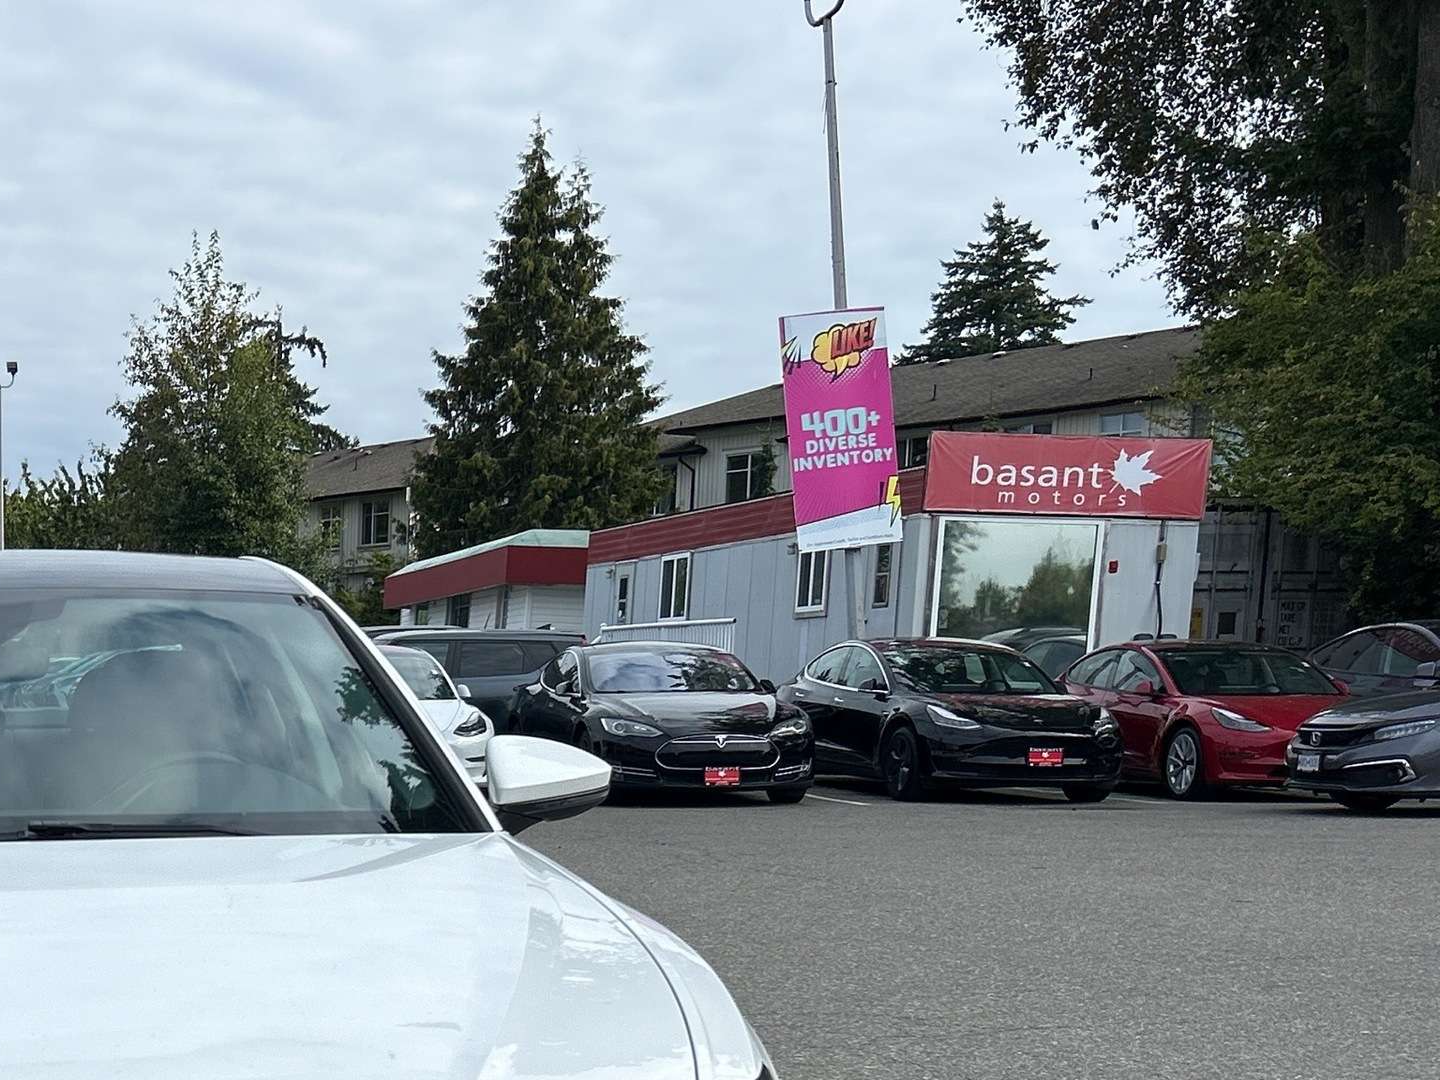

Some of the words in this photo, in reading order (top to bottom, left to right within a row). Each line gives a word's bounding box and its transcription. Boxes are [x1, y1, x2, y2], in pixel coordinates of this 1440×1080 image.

[830, 318, 877, 359] LIKE!
[800, 407, 880, 437] 400+
[805, 433, 877, 454] DIVERSE
[793, 448, 893, 472] INVENTORY
[970, 455, 1104, 489] basant
[997, 490, 1127, 507] motors
